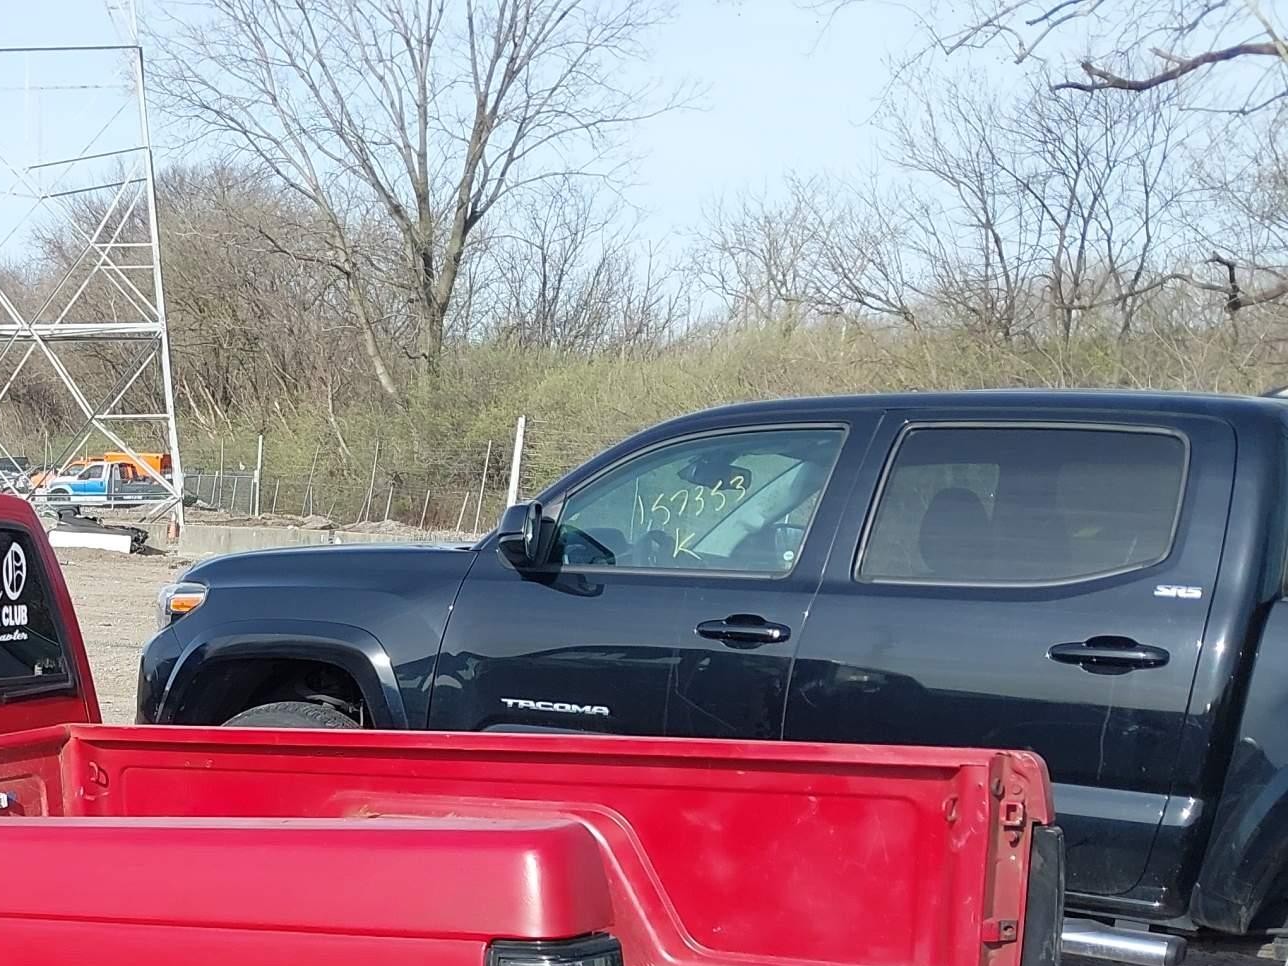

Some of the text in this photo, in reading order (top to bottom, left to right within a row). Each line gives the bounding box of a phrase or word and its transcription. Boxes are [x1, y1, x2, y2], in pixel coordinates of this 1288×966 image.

[1153, 585, 1203, 599] SR5
[2, 604, 28, 627] CLUB
[500, 698, 610, 716] TACOMA
